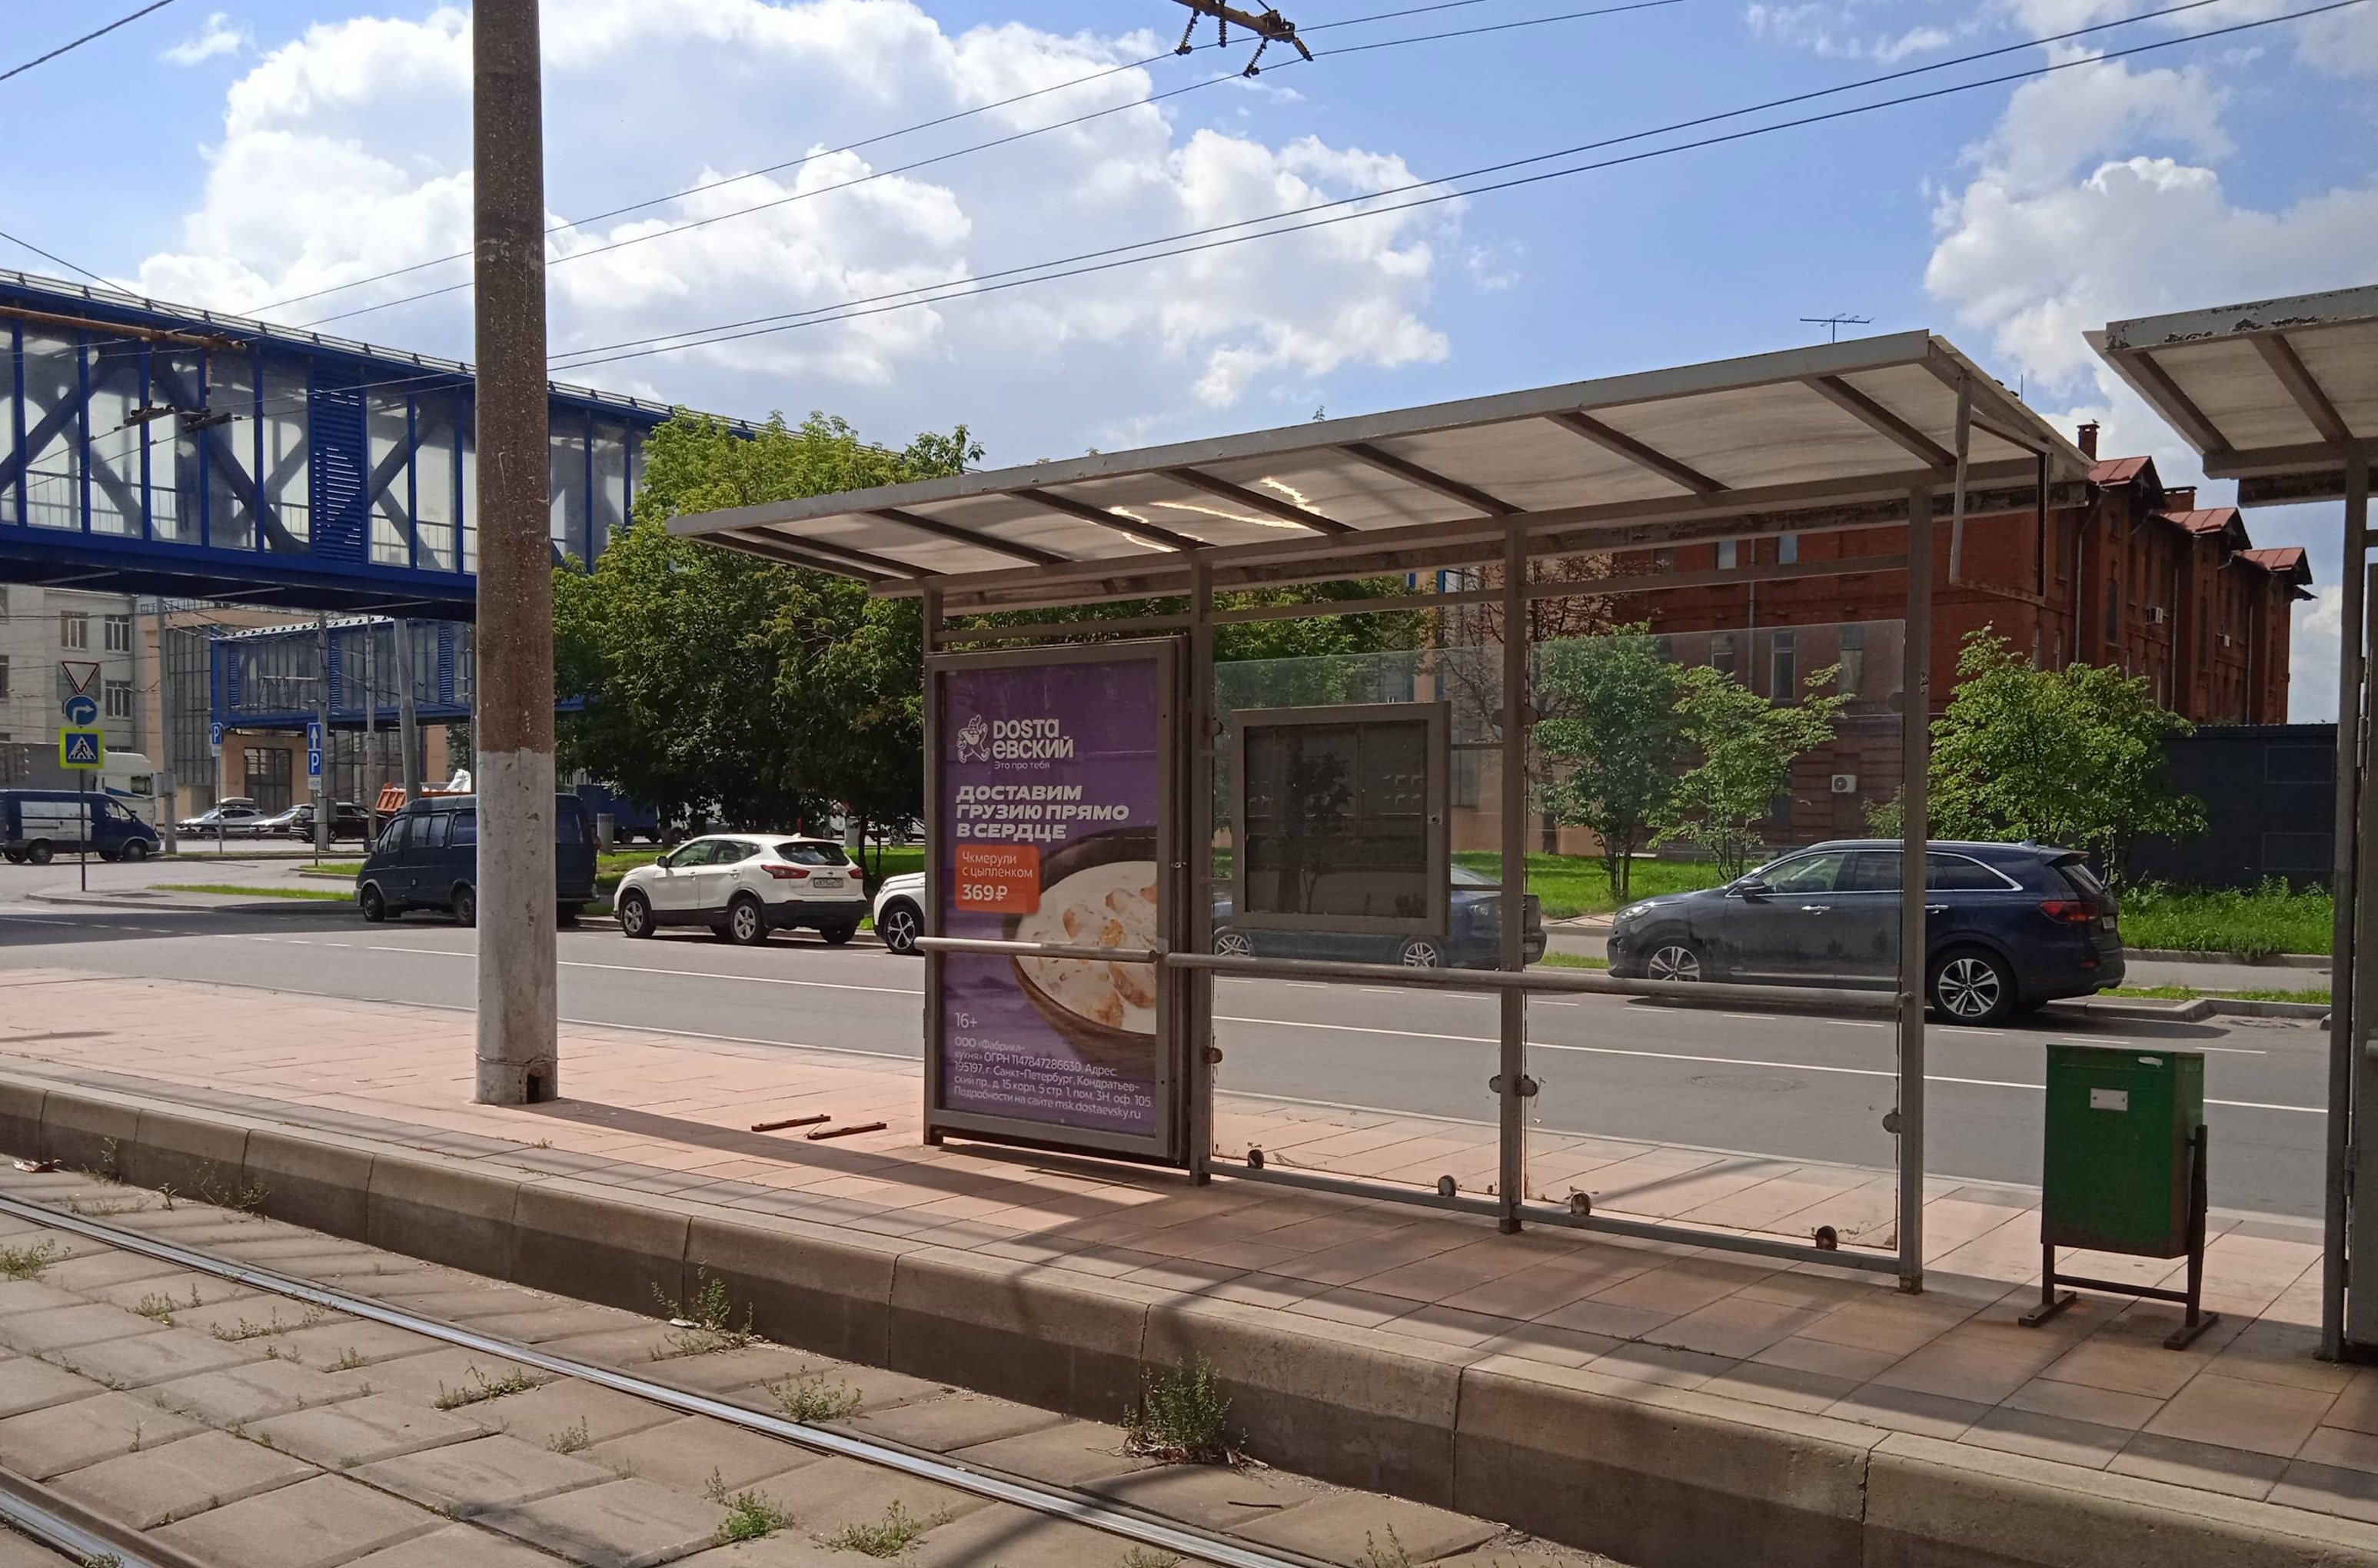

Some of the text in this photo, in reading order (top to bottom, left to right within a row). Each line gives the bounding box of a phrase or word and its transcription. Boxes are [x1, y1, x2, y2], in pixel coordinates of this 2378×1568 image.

[214, 726, 220, 743] P
[311, 752, 319, 773] P
[994, 761, 1050, 771] Это про тебя
[956, 786, 1083, 803] ДОСТАВИМ
[956, 805, 1129, 821] ГРУЗИЮ ПРЯМО
[956, 823, 1067, 842] В СЕРДЦЕ
[962, 851, 1016, 868] Чкмерули
[970, 867, 1033, 879] цыпленком
[955, 1012, 978, 1028] 16+
[954, 1037, 976, 1048] ООО
[984, 1051, 1010, 1064] ОГРН
[1002, 1078, 1012, 1090] 15
[1038, 1084, 1045, 1094] 5
[1077, 1075, 1140, 1091] Кондратьев-
[954, 1085, 1142, 1121] Подробности на сайте msk.dostaevsky.ru
